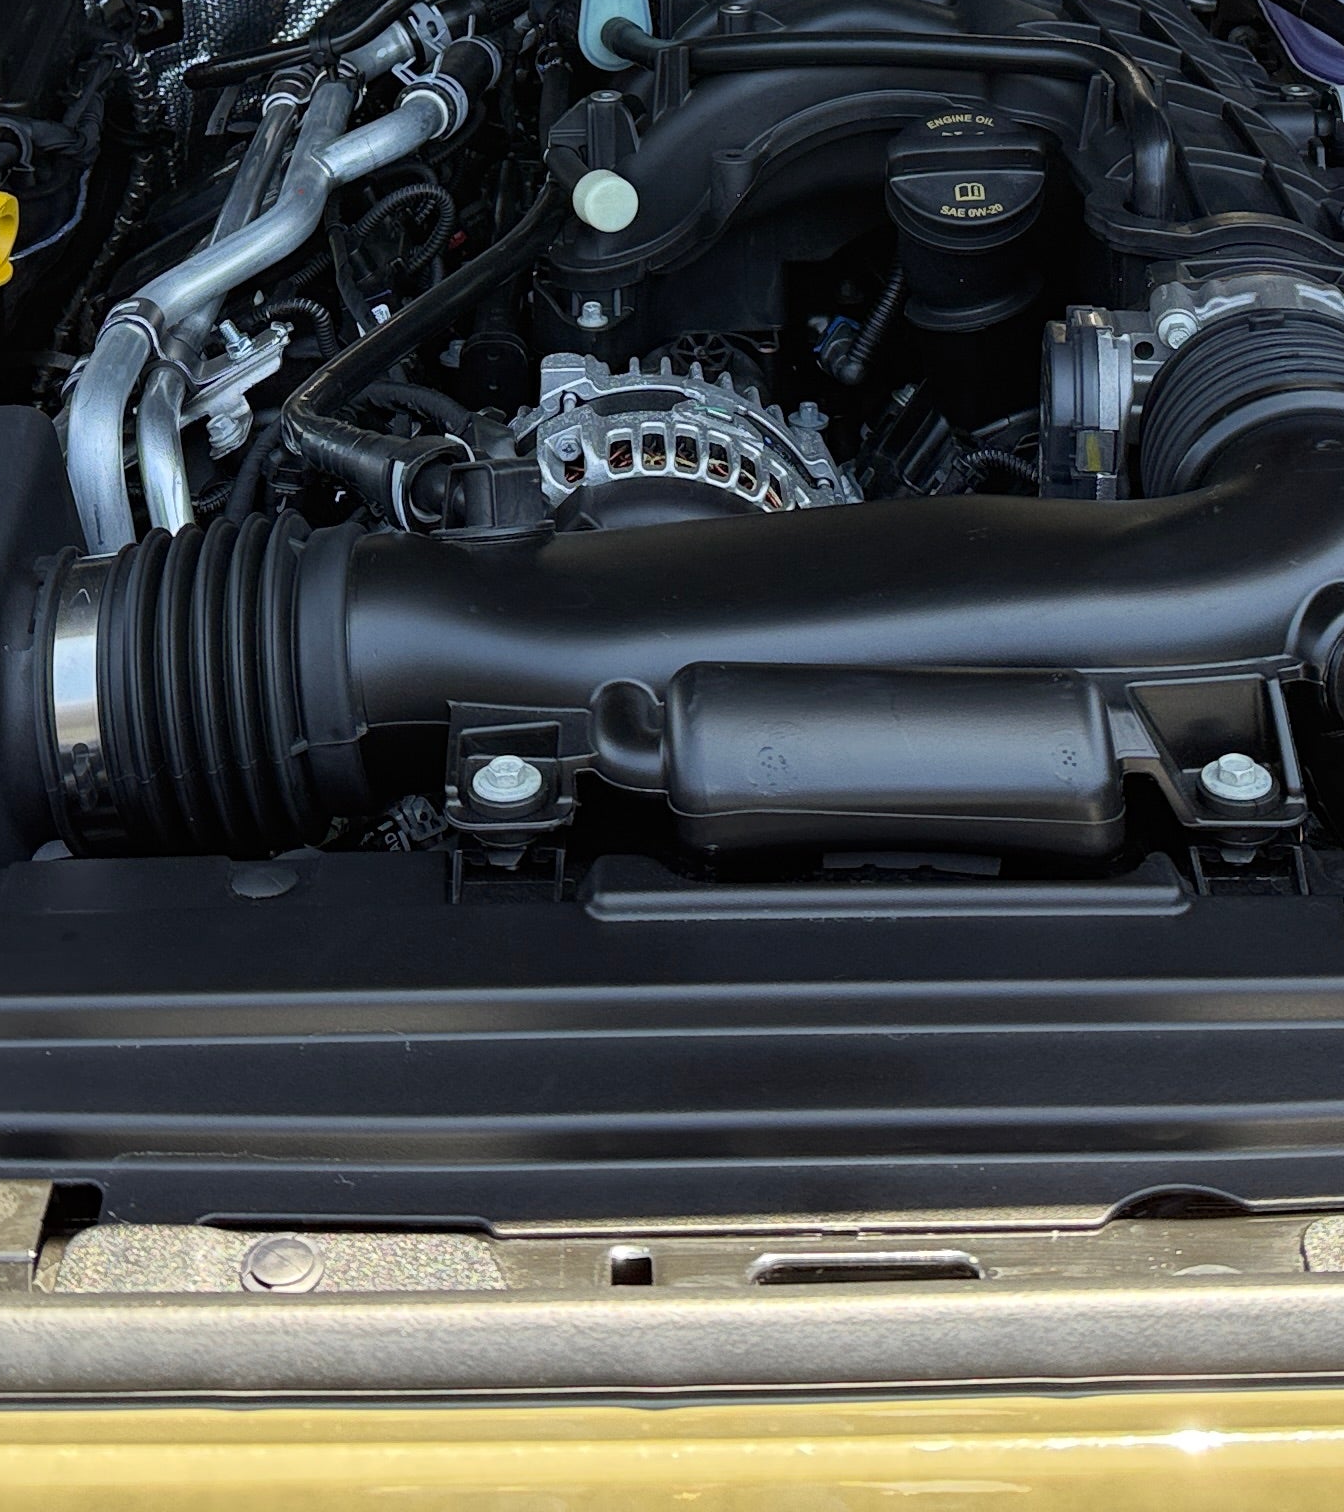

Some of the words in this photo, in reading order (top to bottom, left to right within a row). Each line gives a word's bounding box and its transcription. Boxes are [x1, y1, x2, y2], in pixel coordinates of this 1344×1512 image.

[926, 114, 973, 130] ENGINE
[975, 115, 995, 127] OIL
[940, 205, 966, 218] SAE
[968, 203, 1004, 218] 0W-20
